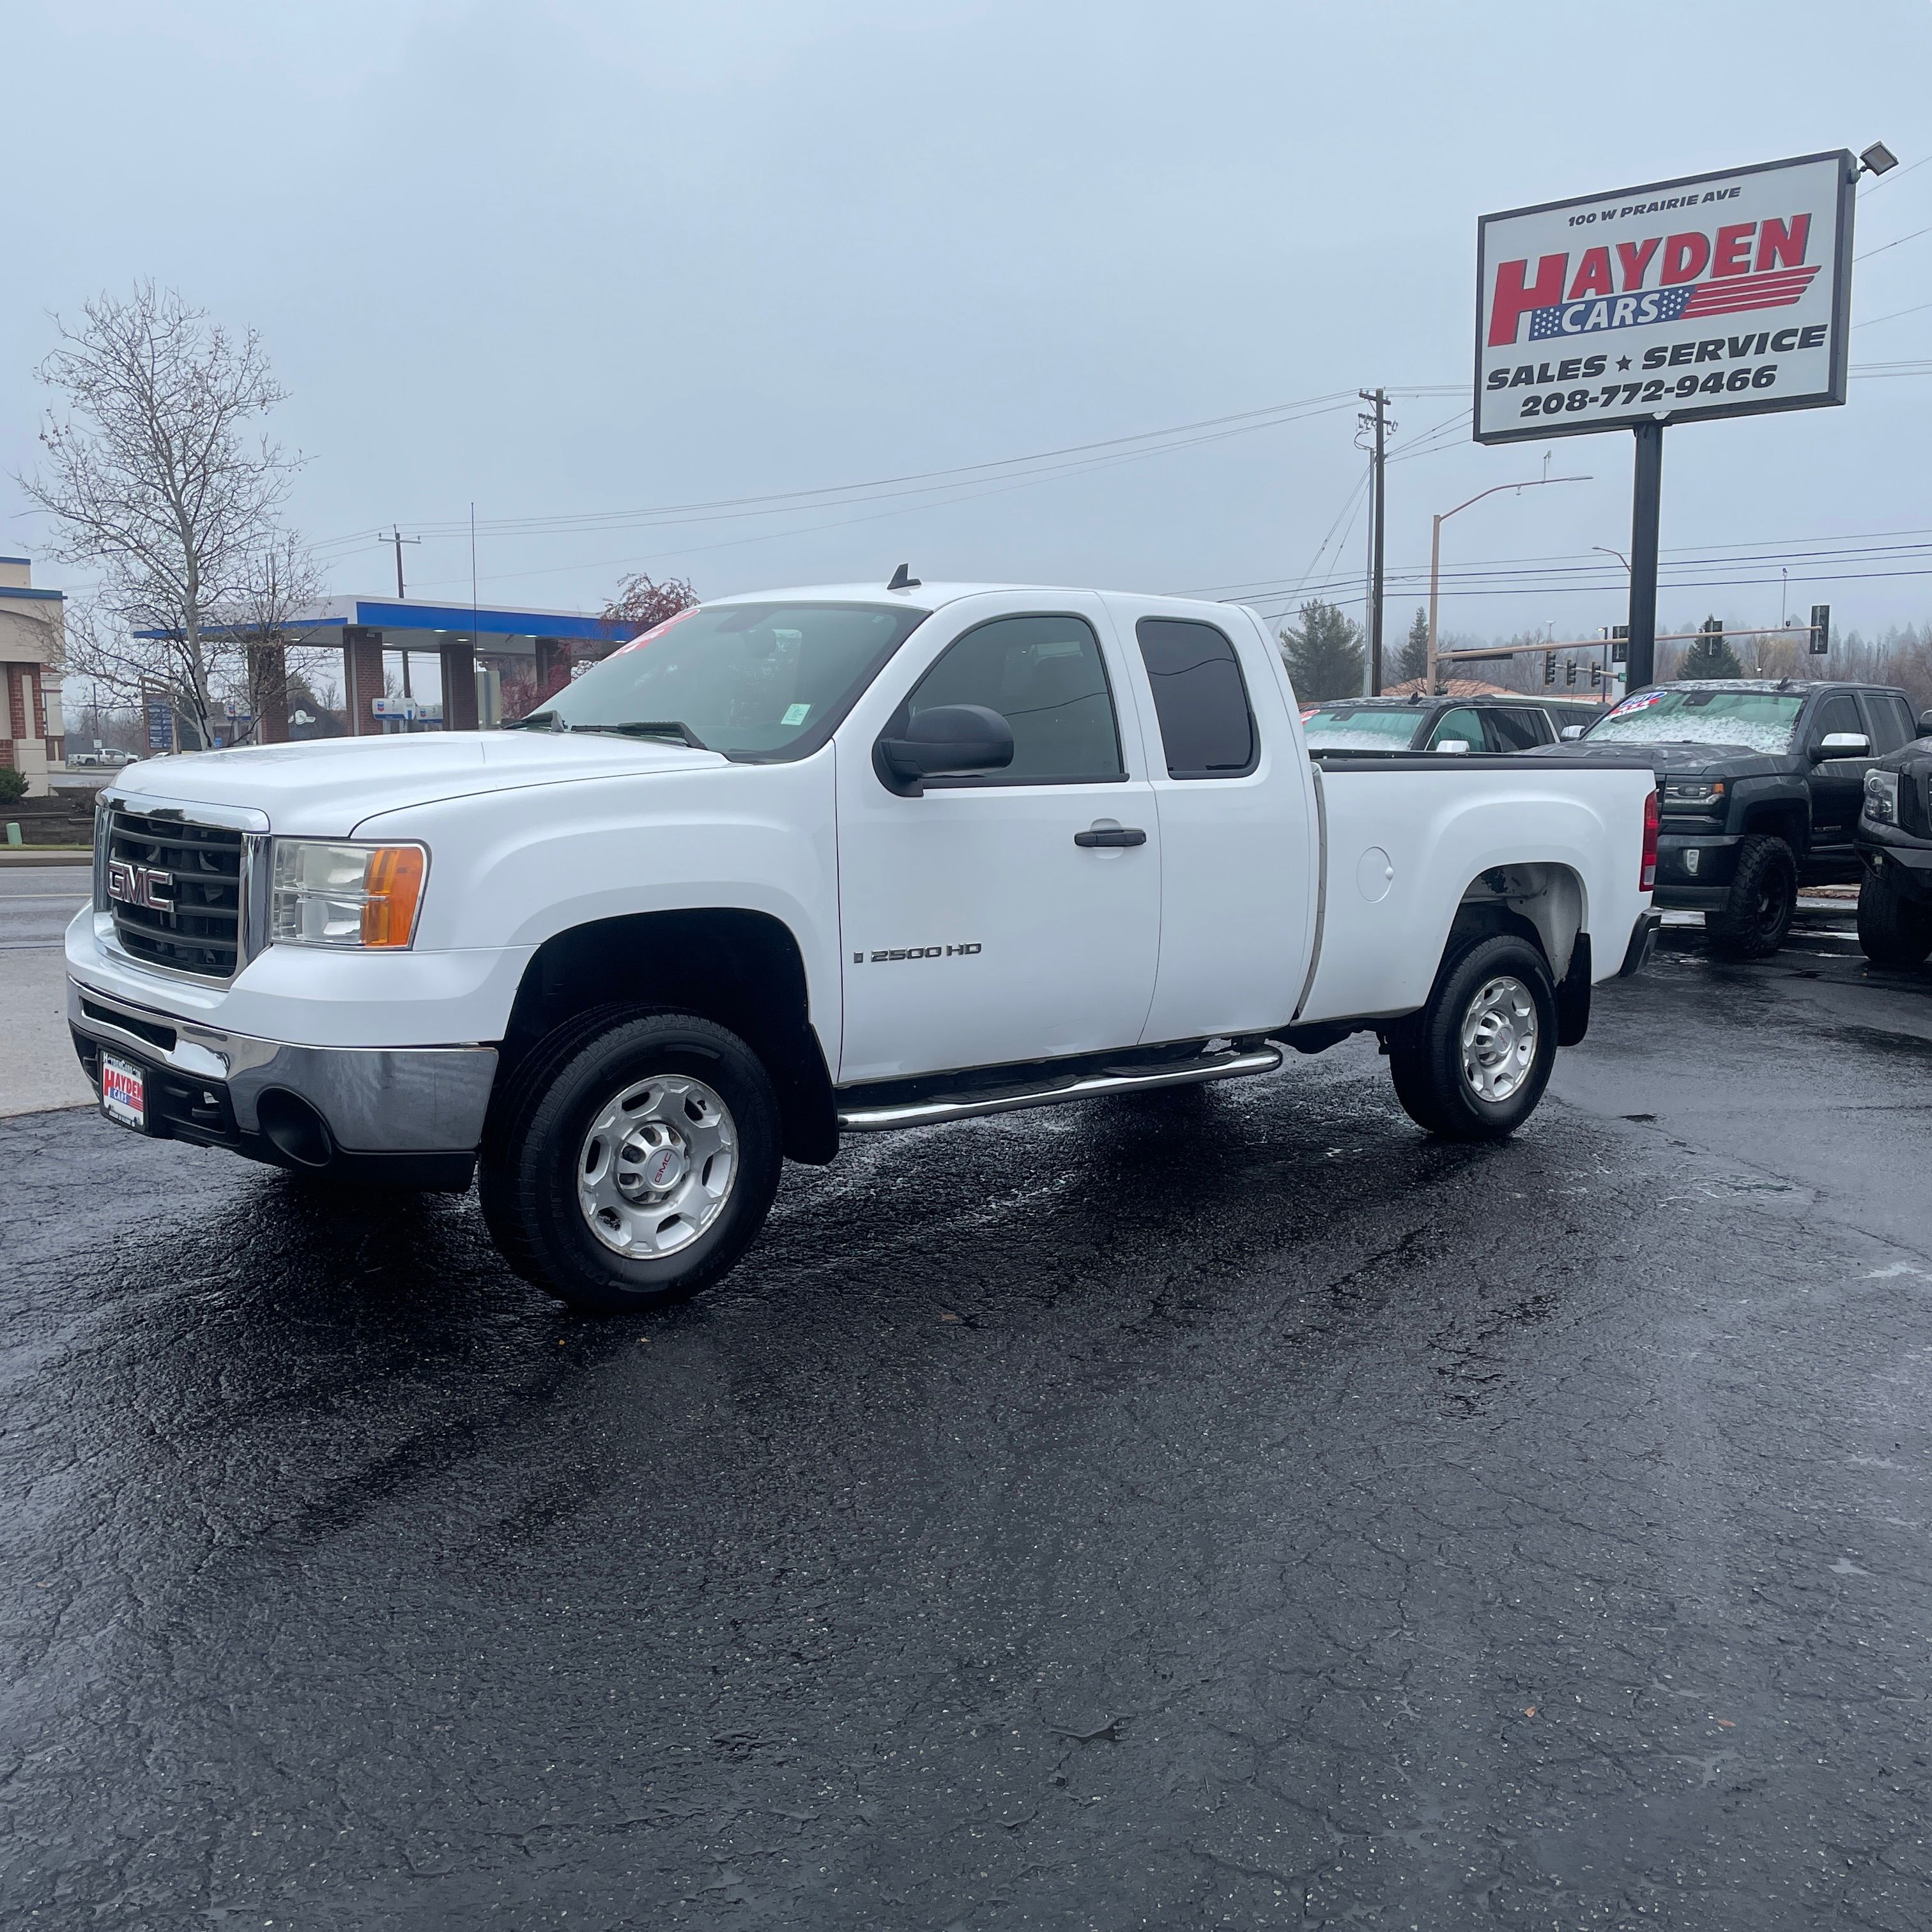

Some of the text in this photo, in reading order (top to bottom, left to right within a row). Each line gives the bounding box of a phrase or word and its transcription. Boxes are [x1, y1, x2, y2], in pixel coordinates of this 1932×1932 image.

[1568, 187, 1742, 227] 100 W PRAIRIE AVE
[1487, 213, 1813, 347] HAYDEN
[1561, 293, 1661, 333] CARS
[1486, 324, 1828, 390] SALES SERVICE
[1520, 365, 1778, 418] 208-772-9466
[107, 860, 174, 913] GMC
[871, 942, 982, 962] 2500 HD
[104, 1068, 144, 1101] HAYDEN
[113, 1089, 128, 1104] CARS
[655, 1152, 672, 1183] GMC
